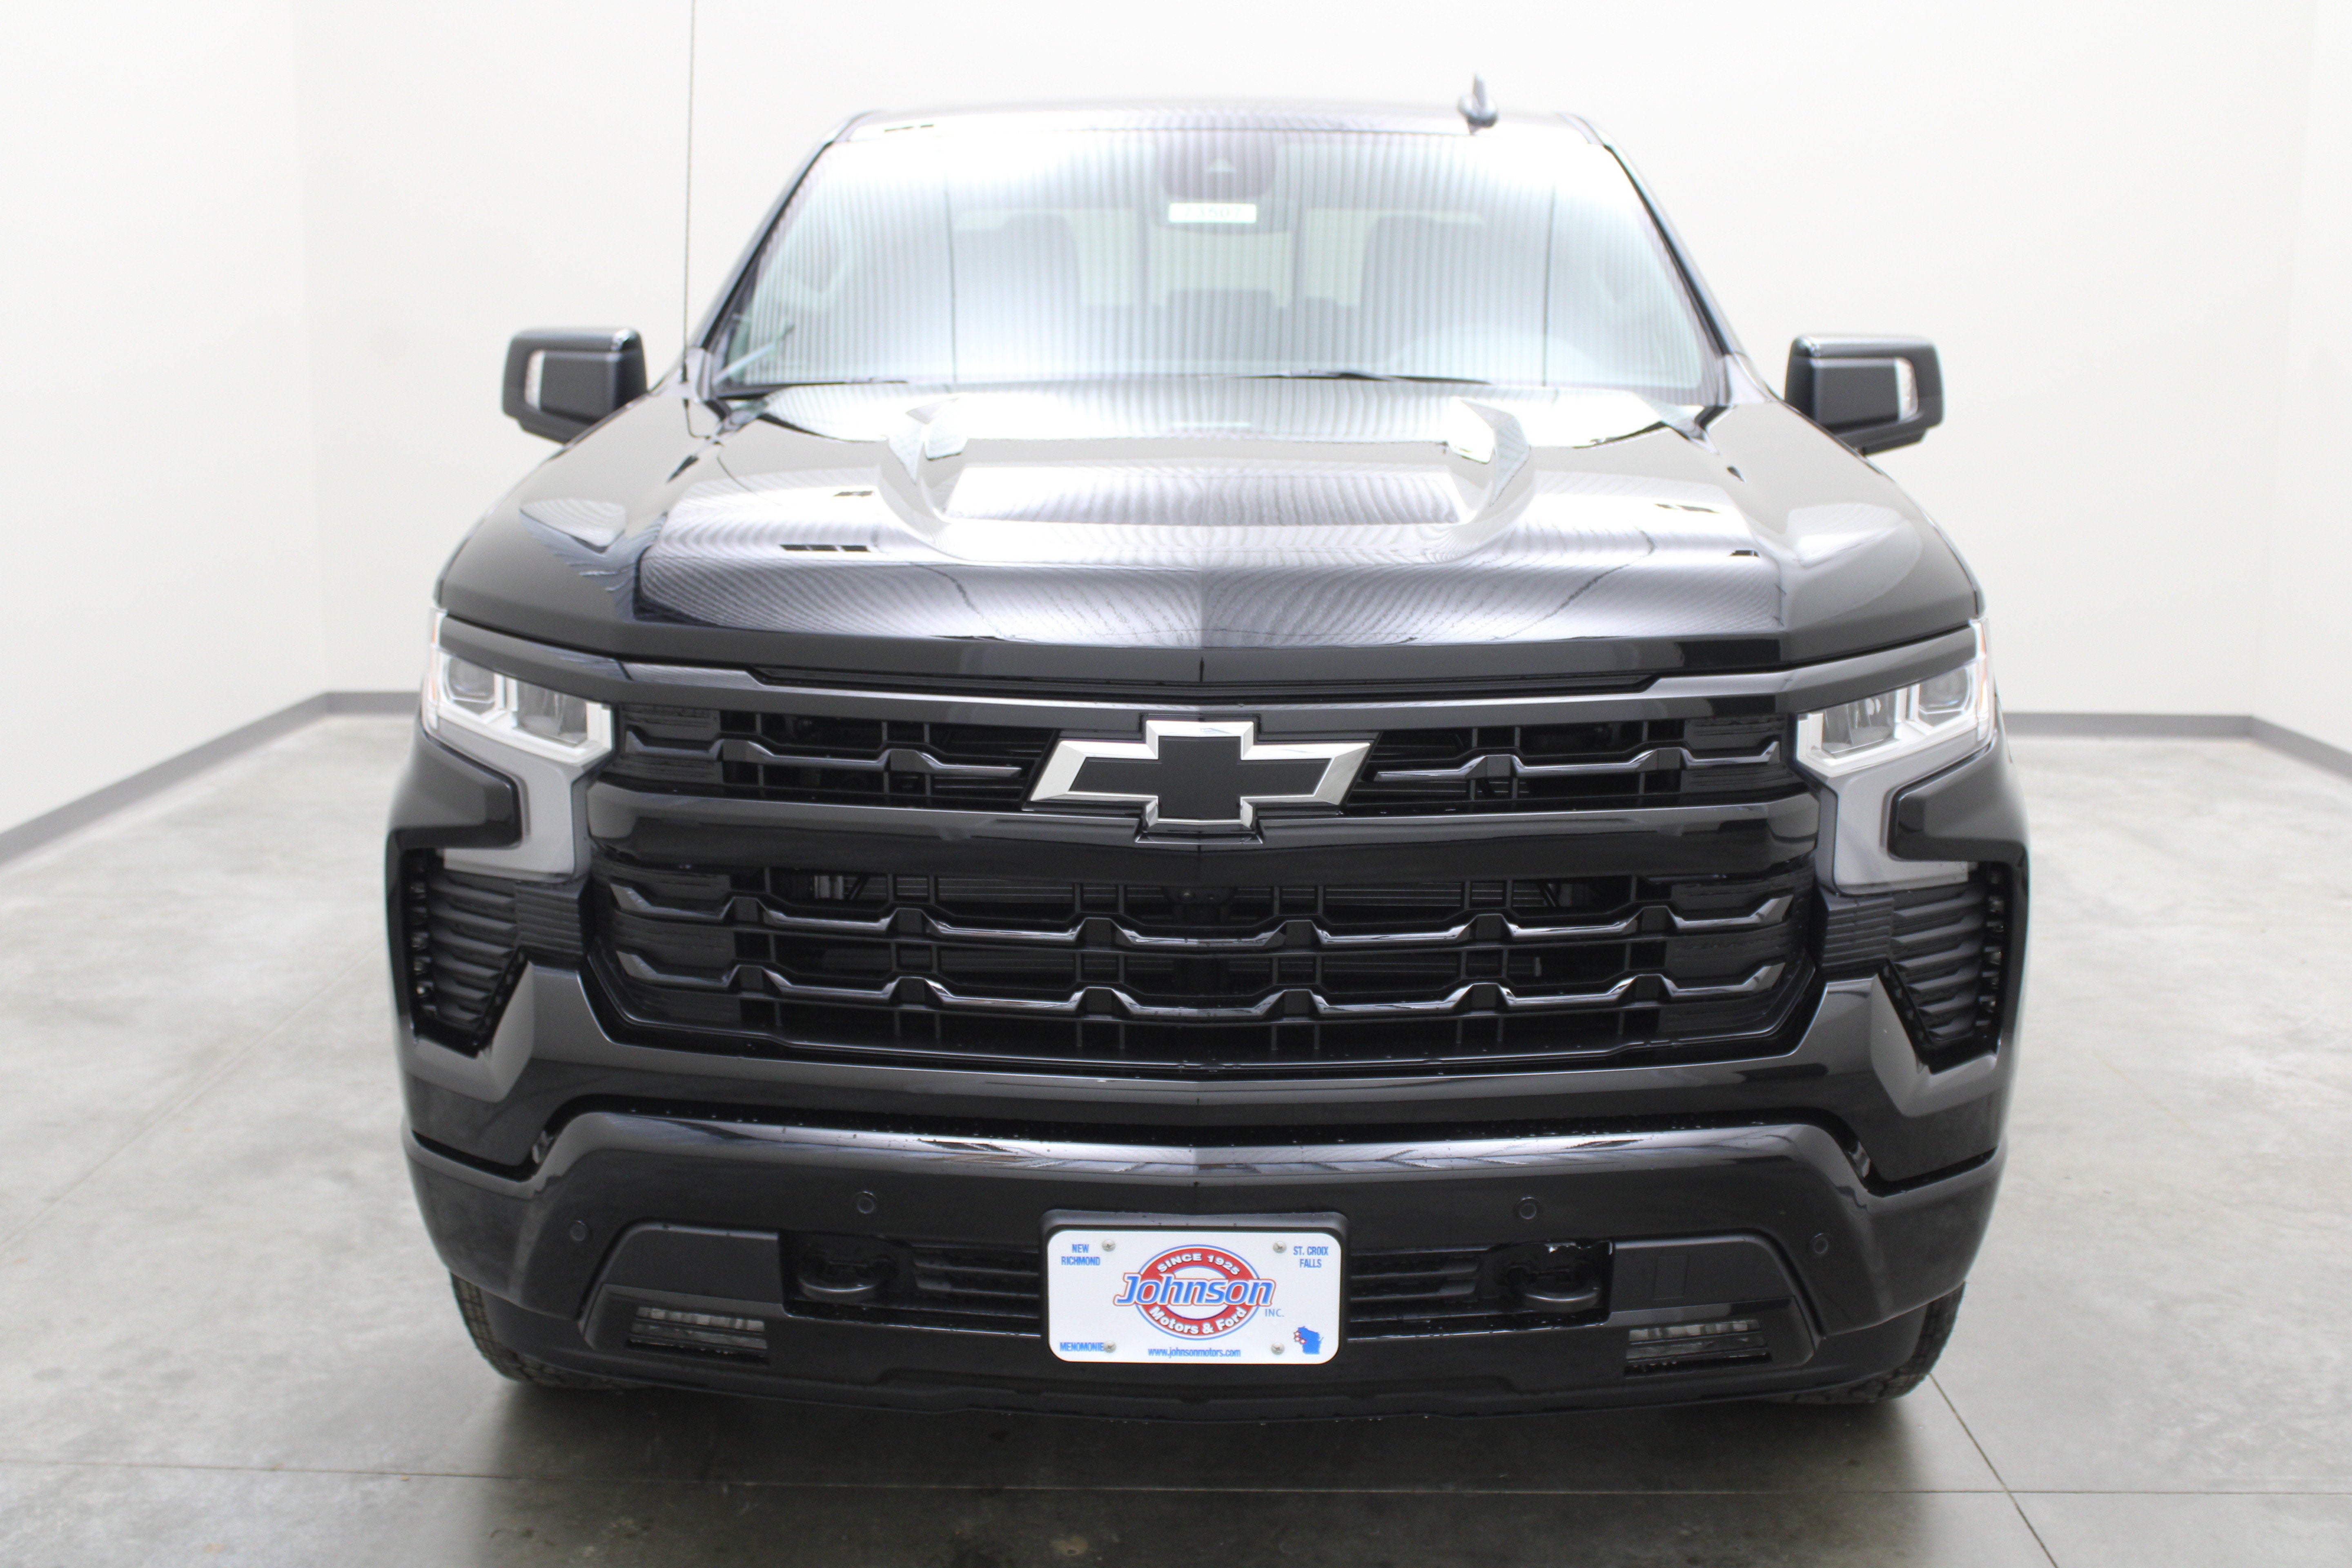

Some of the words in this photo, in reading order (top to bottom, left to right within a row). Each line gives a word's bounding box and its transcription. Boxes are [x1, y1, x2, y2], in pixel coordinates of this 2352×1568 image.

[1072, 1244, 1089, 1253] NEW
[1293, 1246, 1305, 1256] ST.
[1307, 1246, 1328, 1256] CROIX
[1061, 1256, 1100, 1266] RICHMOND
[1157, 1253, 1202, 1273] SINCE
[1207, 1255, 1241, 1275] 1925
[1300, 1259, 1322, 1268] FALLS
[1116, 1275, 1274, 1305] Johnson
[1265, 1309, 1285, 1317] INC.
[1149, 1306, 1199, 1334] Motors
[1202, 1322, 1214, 1334] &
[1215, 1306, 1247, 1331] Ford
[1060, 1342, 1105, 1352] MENOMONIE
[1148, 1348, 1241, 1358] www.johnsonmotors.com
